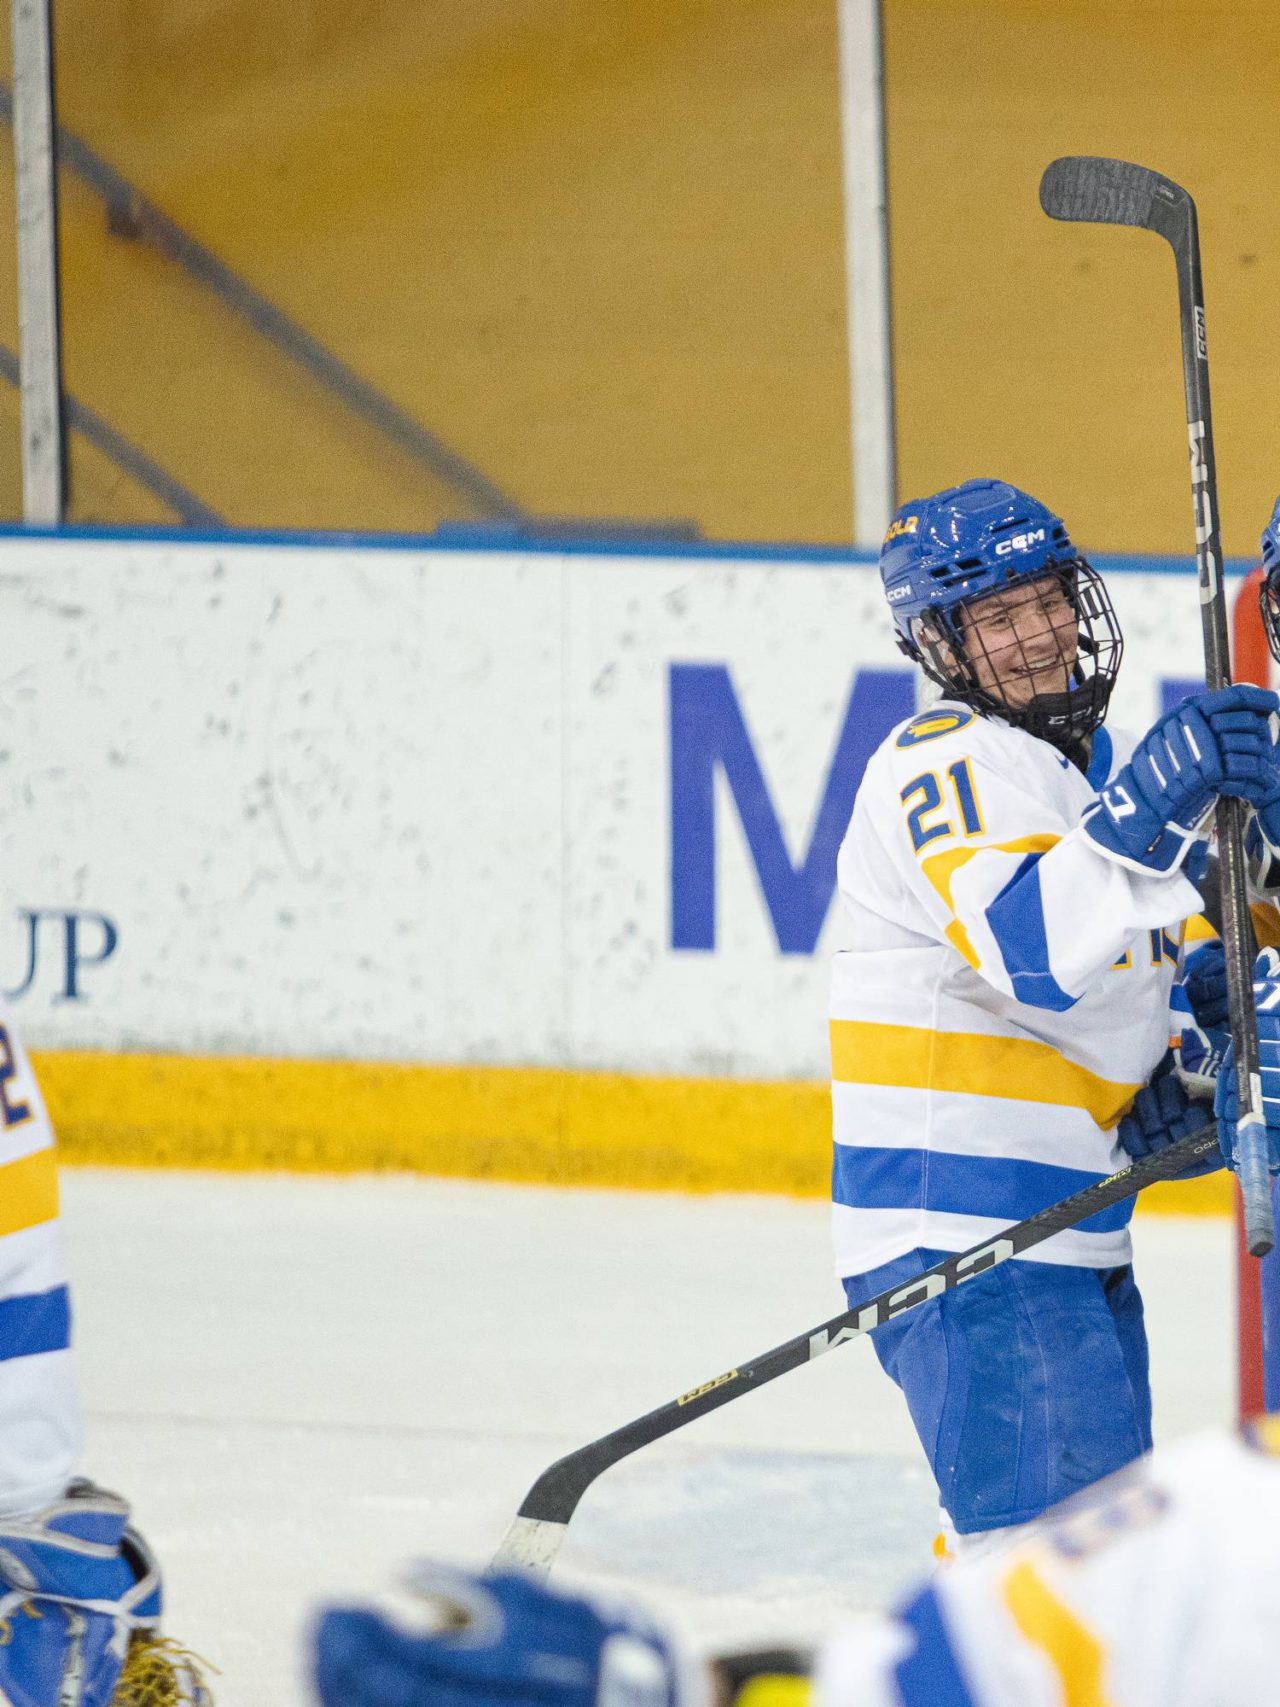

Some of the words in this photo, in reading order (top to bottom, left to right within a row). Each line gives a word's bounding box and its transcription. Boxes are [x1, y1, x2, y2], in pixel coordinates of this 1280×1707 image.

[995, 528, 1045, 555] CCM
[1187, 420, 1218, 605] CCM
[888, 584, 911, 601] CCM
[900, 754, 986, 857] 21
[809, 1239, 1014, 1361] CCM
